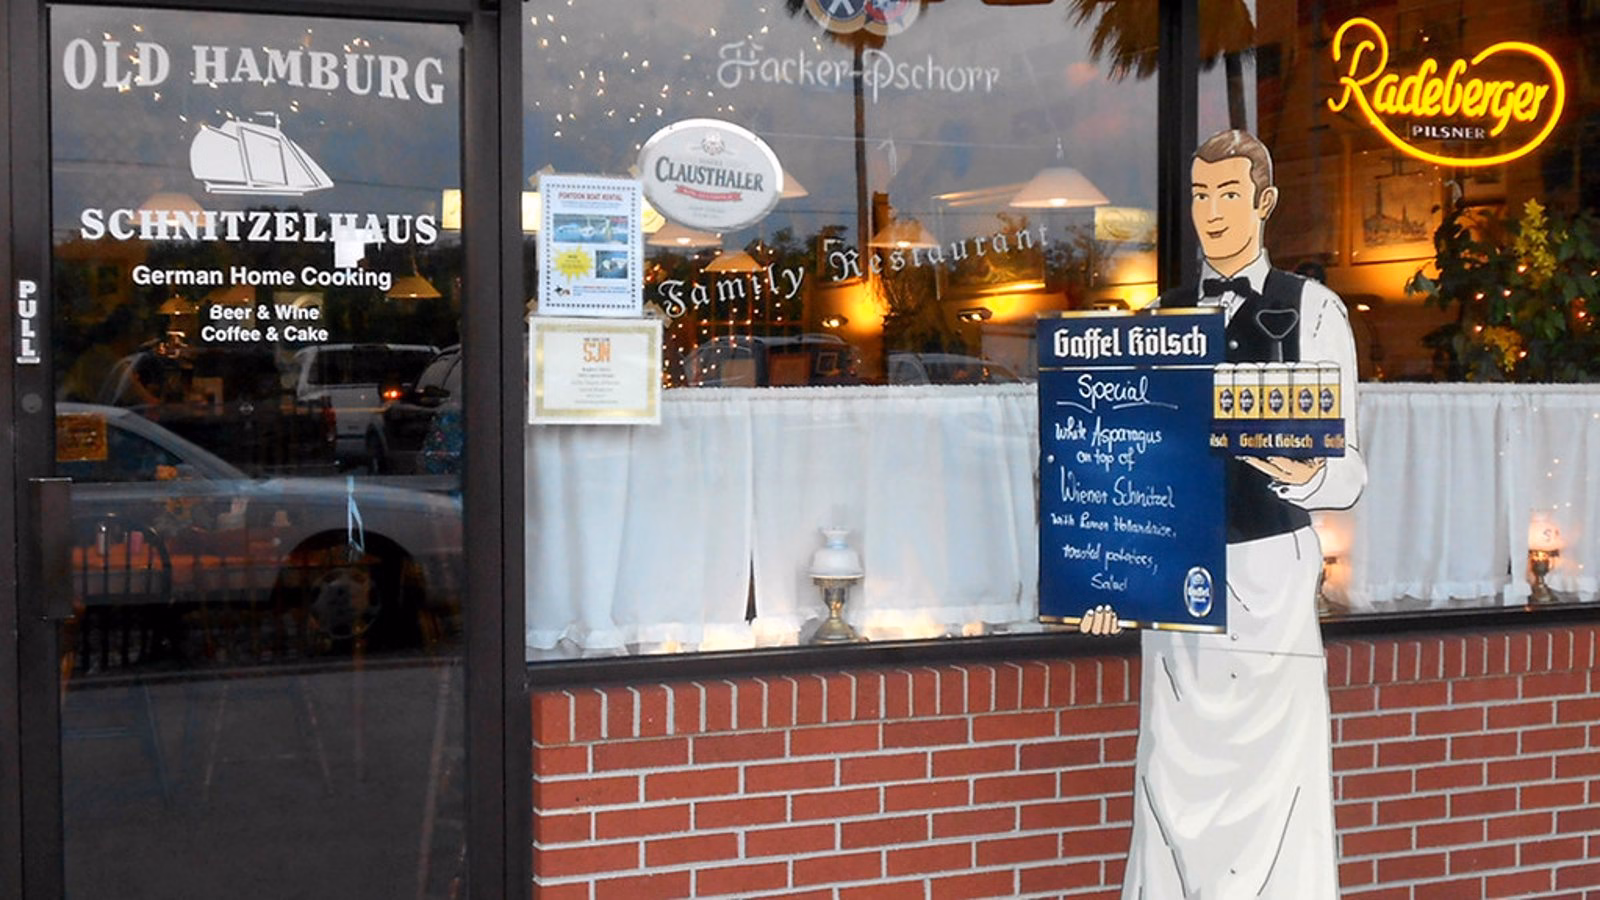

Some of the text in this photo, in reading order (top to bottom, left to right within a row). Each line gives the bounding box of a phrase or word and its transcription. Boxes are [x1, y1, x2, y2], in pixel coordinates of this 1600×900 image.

[63, 38, 445, 104] OLD HAMBURG
[1328, 17, 1549, 138] Radeberger
[1412, 125, 1485, 139] PILSNER
[655, 156, 764, 192] CLAUSTHALER
[80, 207, 438, 245] SCHNITZELHAUS
[132, 265, 392, 291] German Home Cooking
[658, 223, 1048, 319] Family Restaurant
[18, 280, 37, 358] PULL
[209, 304, 320, 320] Beer & Wine
[201, 325, 329, 342] Coffee & Cake
[1054, 325, 1207, 359] Gaffel Kölsch
[1077, 373, 1150, 409] Special
[1091, 416, 1162, 454] Asparagus
[1076, 446, 1135, 472] on top of
[1061, 465, 1175, 508] Wiener Schnitzel
